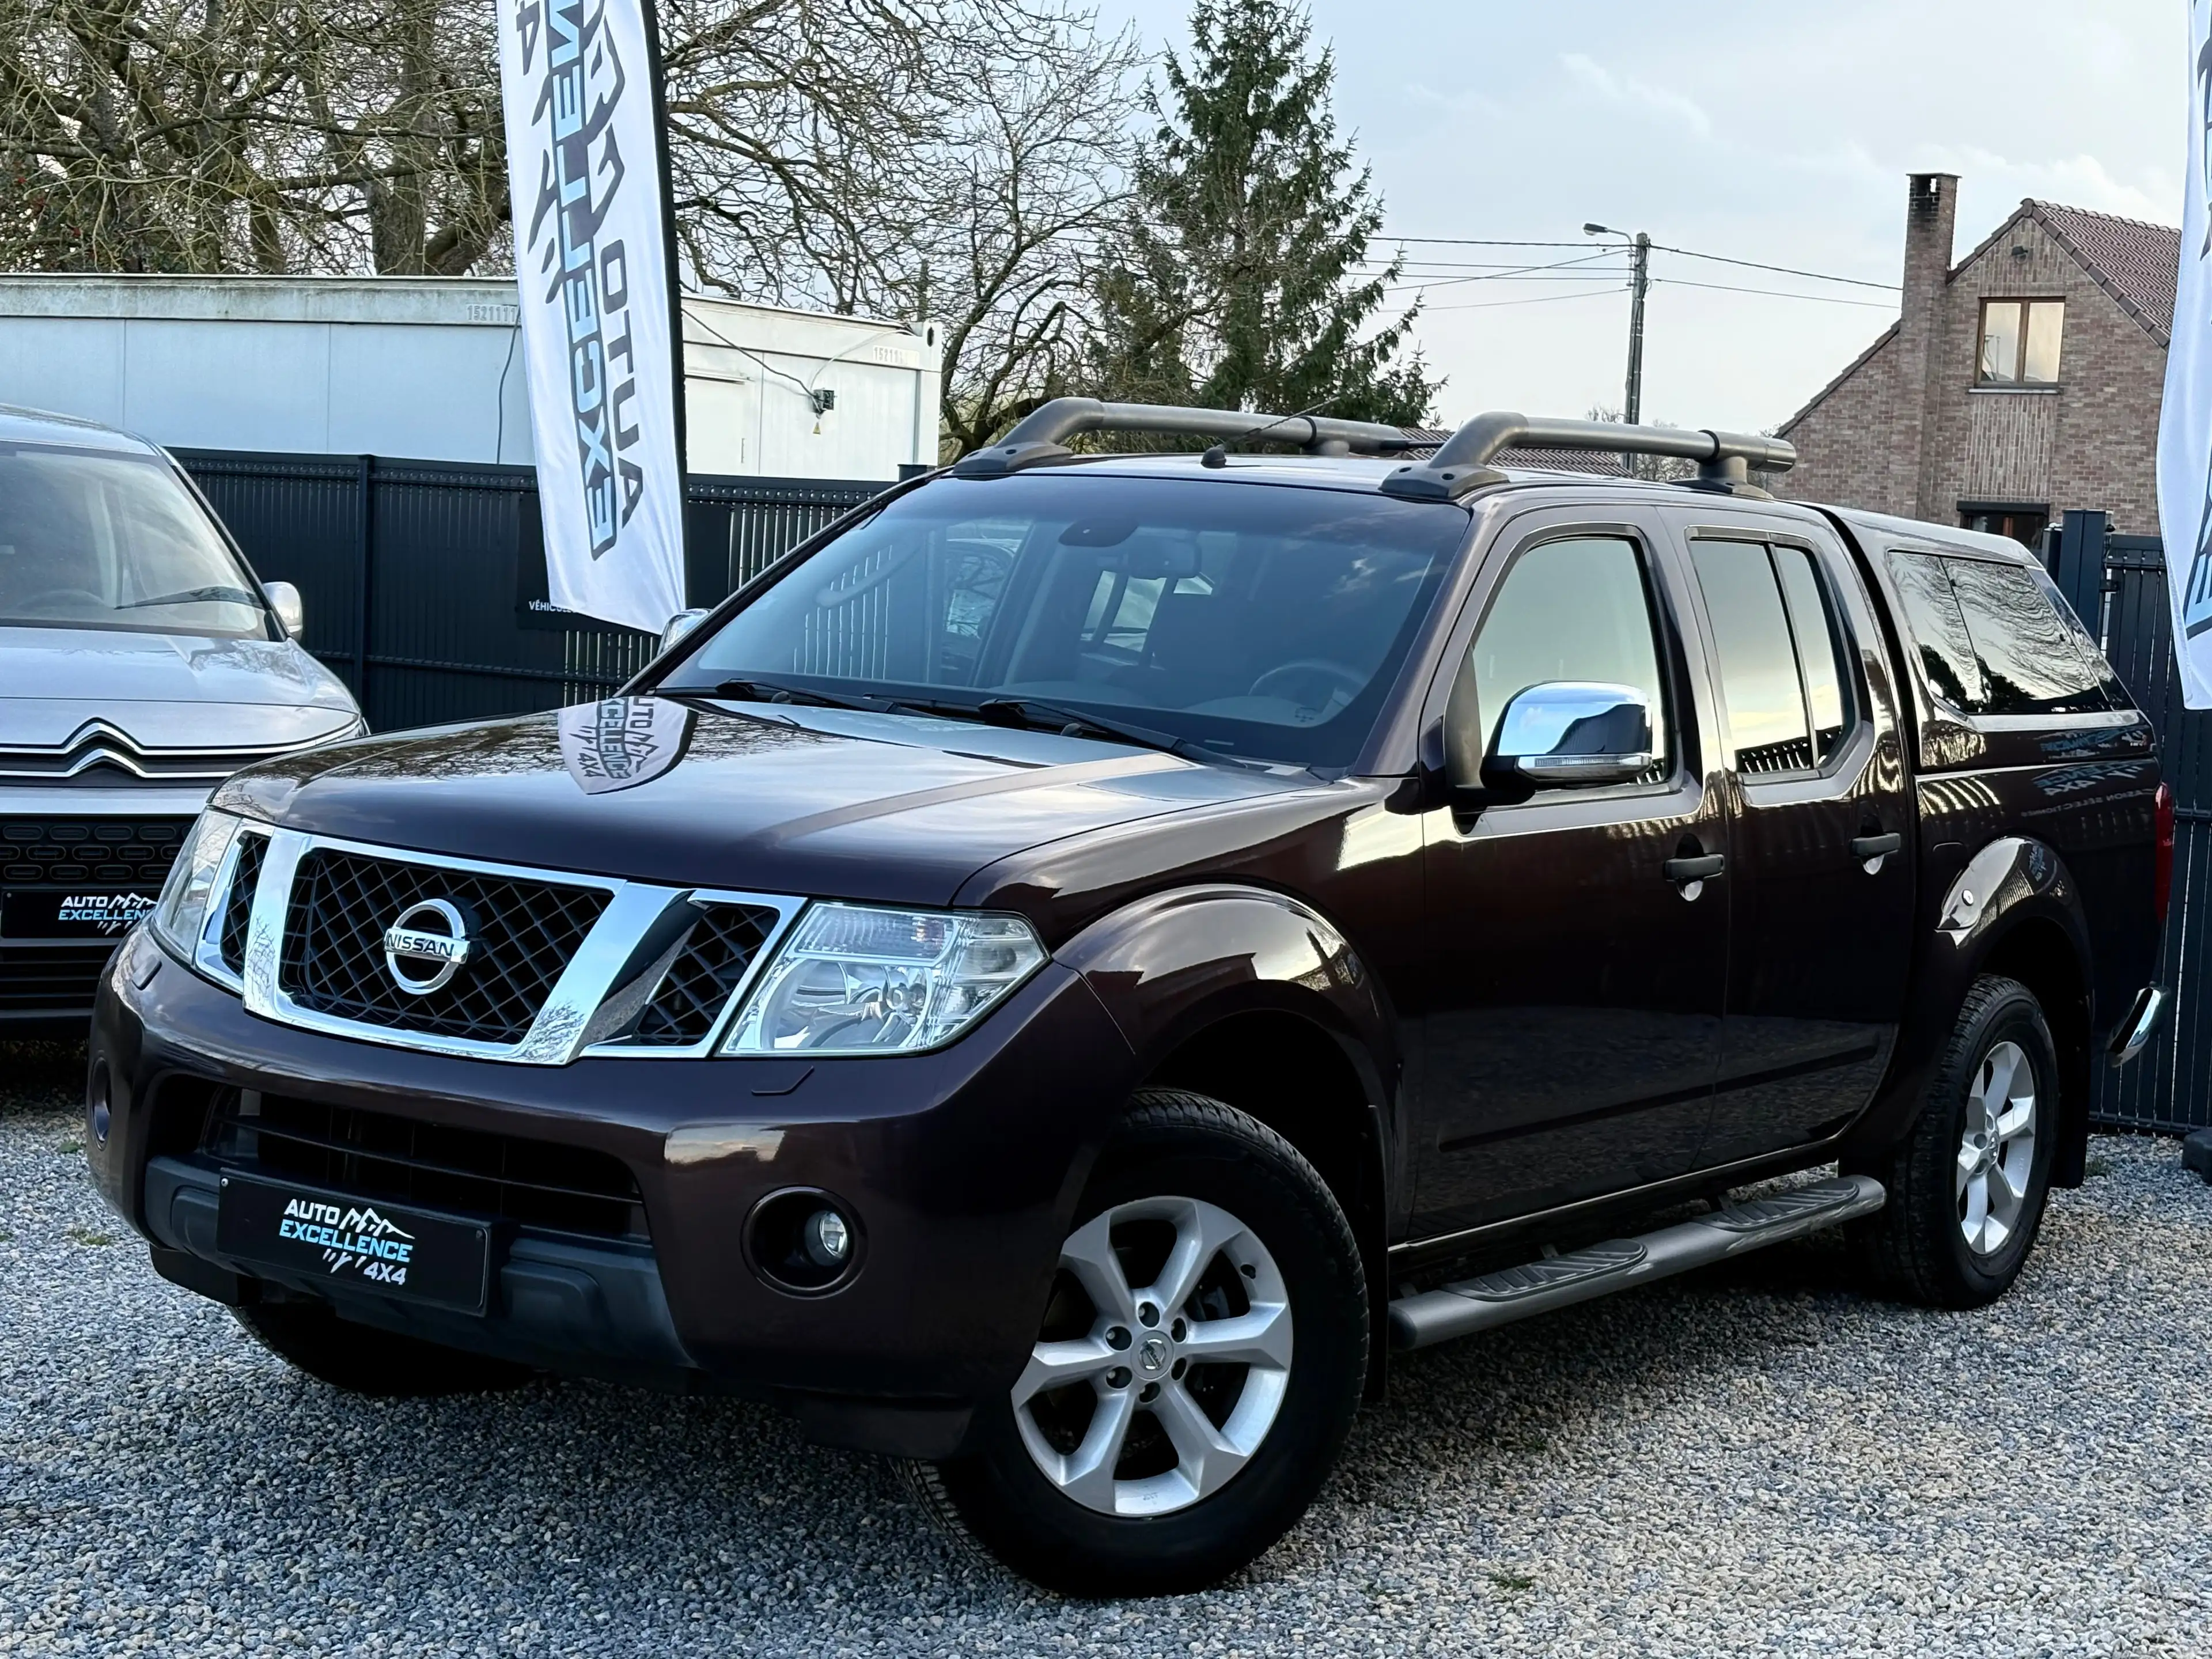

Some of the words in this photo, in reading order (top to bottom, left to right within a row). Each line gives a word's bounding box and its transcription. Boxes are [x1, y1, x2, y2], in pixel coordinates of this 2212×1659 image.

[467, 305, 521, 323] 1521111
[60, 896, 108, 907] AUTO
[58, 909, 151, 920] EXCELLEN
[386, 931, 454, 957] NISSAN
[283, 1198, 341, 1225] AUTO
[279, 1218, 413, 1263] EXCELLENCE
[363, 1262, 407, 1285] 4X4
